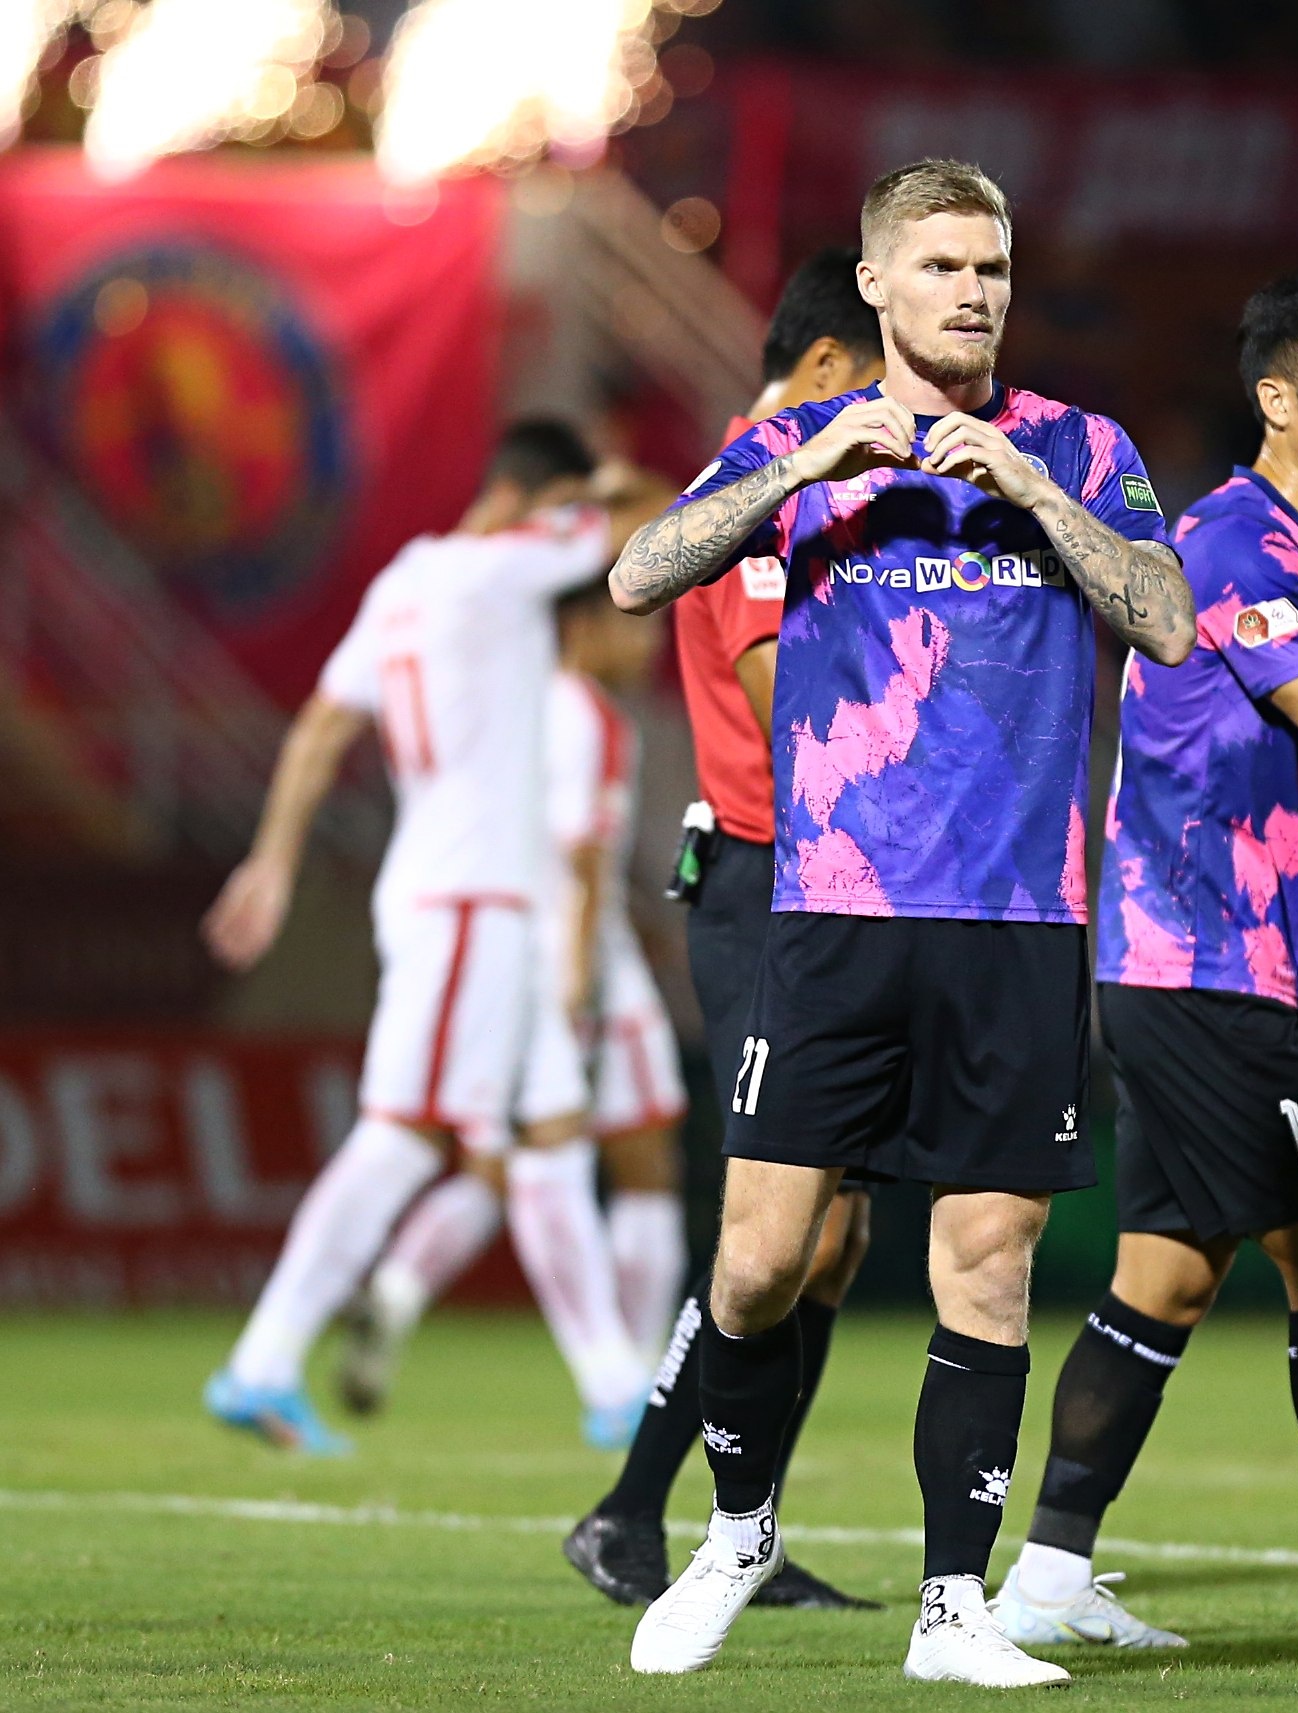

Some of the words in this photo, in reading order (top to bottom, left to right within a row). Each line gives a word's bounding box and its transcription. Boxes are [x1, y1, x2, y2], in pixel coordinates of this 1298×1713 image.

[833, 492, 877, 502] KELME
[829, 551, 1066, 593] NovaWORLD
[732, 1035, 770, 1116] 21
